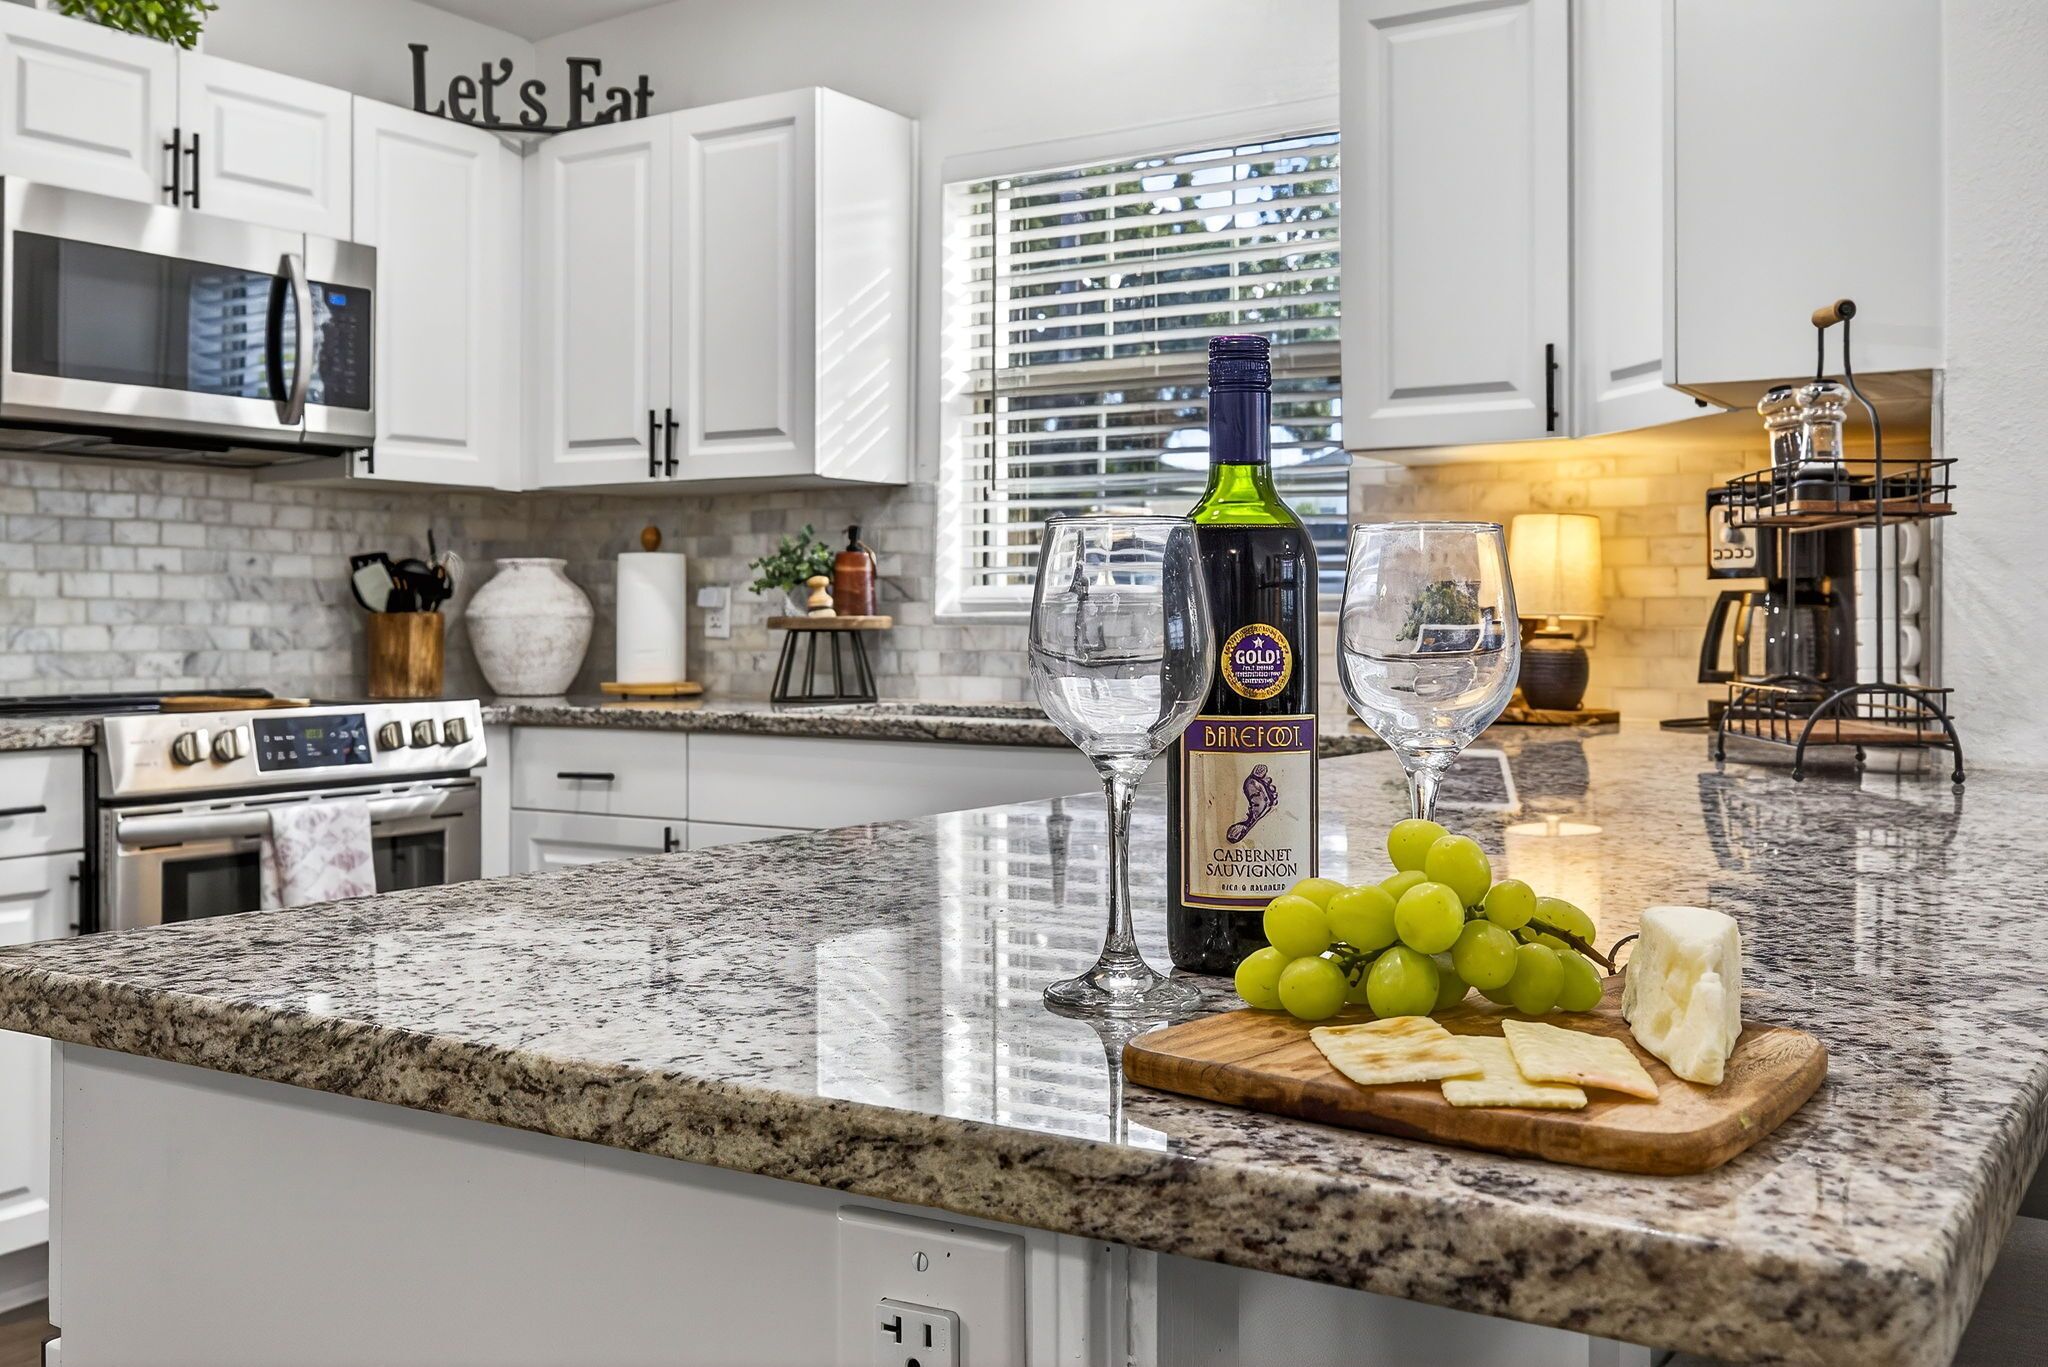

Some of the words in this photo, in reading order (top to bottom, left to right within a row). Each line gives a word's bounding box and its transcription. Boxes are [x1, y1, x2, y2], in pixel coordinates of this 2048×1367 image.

[408, 43, 548, 127] Let's
[566, 56, 655, 128] Eat
[1235, 650, 1281, 665] GOLD!
[1213, 848, 1292, 862] CABERNET
[1206, 863, 1297, 877] SAUVIGNON
